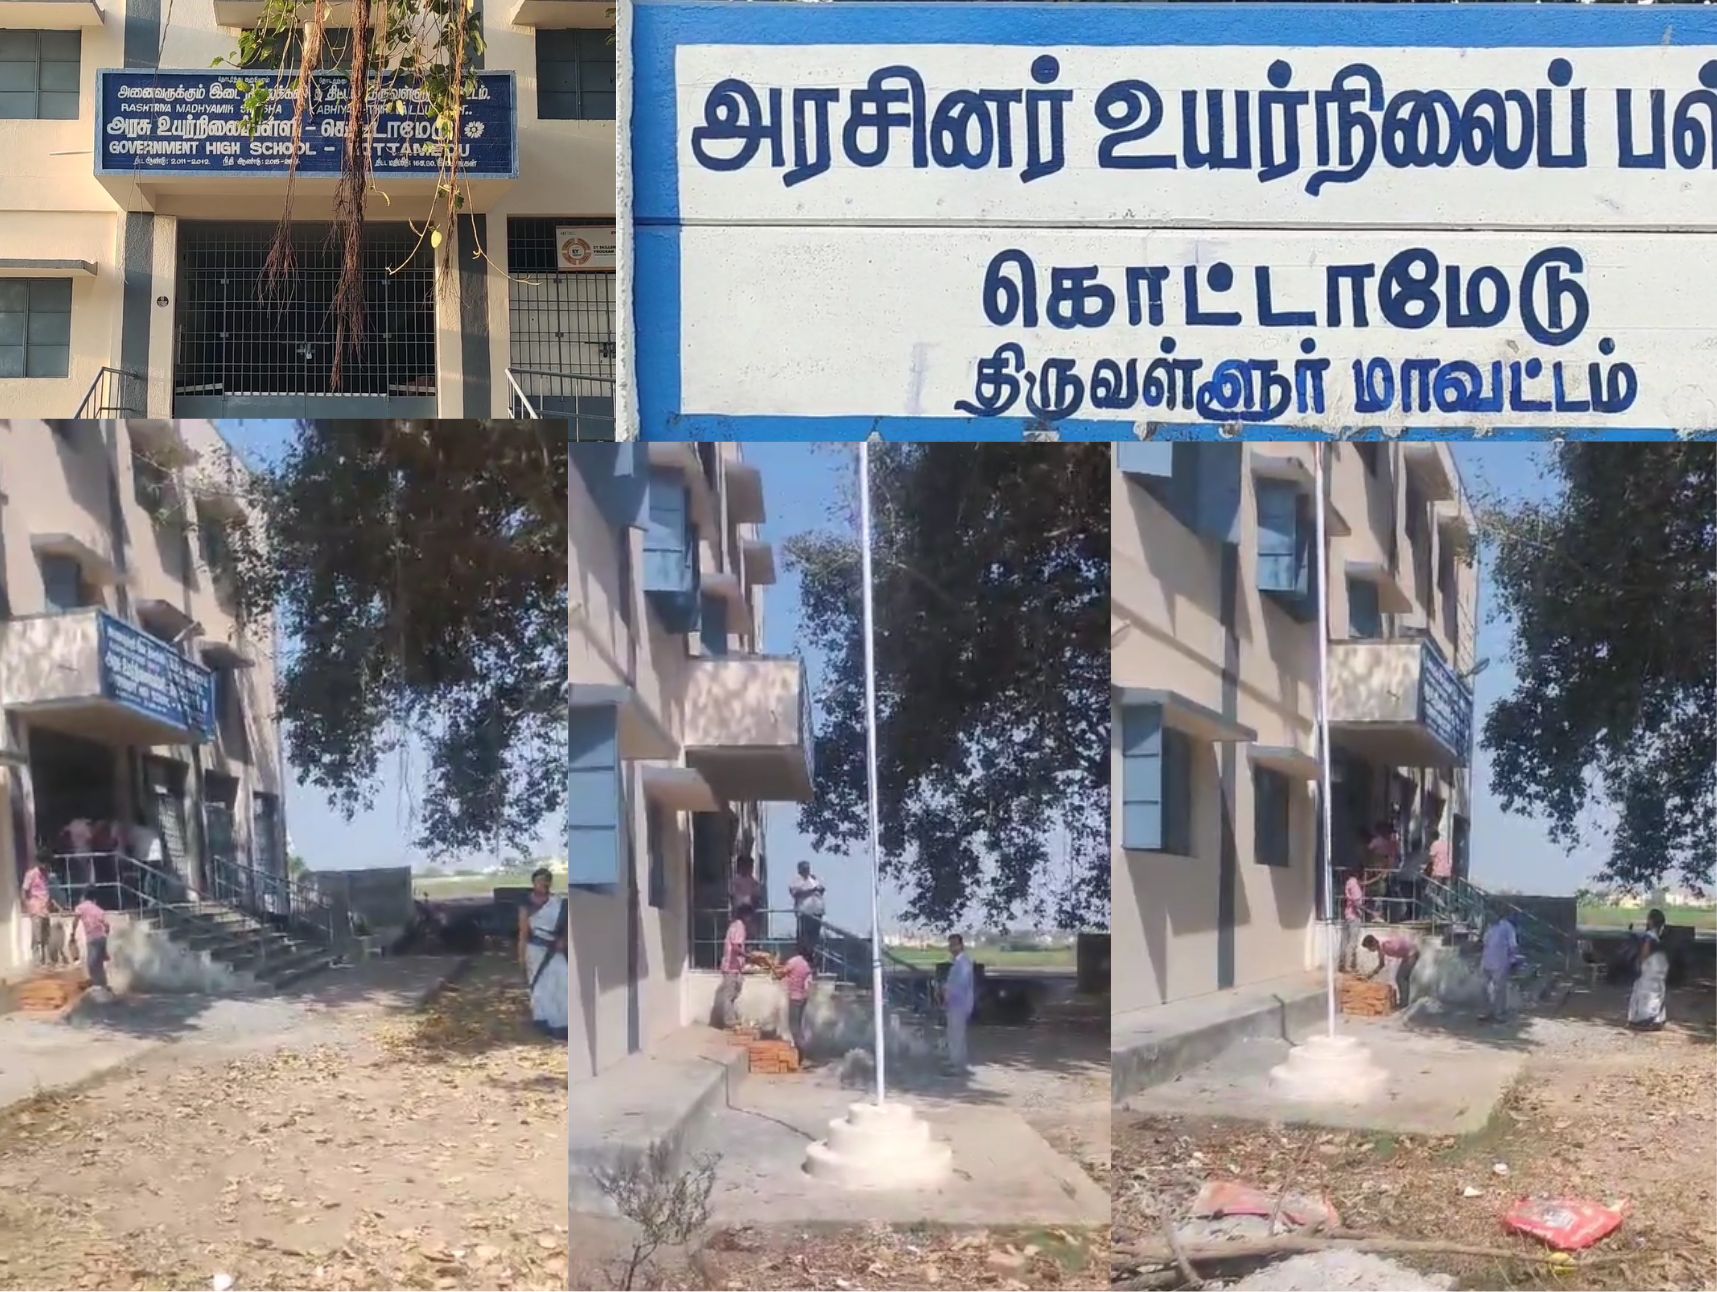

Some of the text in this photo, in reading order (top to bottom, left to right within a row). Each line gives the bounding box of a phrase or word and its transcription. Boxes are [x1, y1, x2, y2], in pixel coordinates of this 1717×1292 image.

[106, 116, 152, 138] அரசு
[121, 103, 172, 113] RASHTRIYA
[176, 103, 234, 114] MADHYAMIK
[691, 54, 1074, 188] அரசினர்
[1095, 58, 1587, 197] உயர்நிலைப்
[109, 141, 199, 155] GOVERNMENT
[205, 141, 240, 155] HIGH
[249, 142, 317, 156] SCHOOL
[982, 246, 1590, 347] கொட்டாமேடு
[954, 336, 1638, 421] திருவள்ளூர் மாவட்டம்
